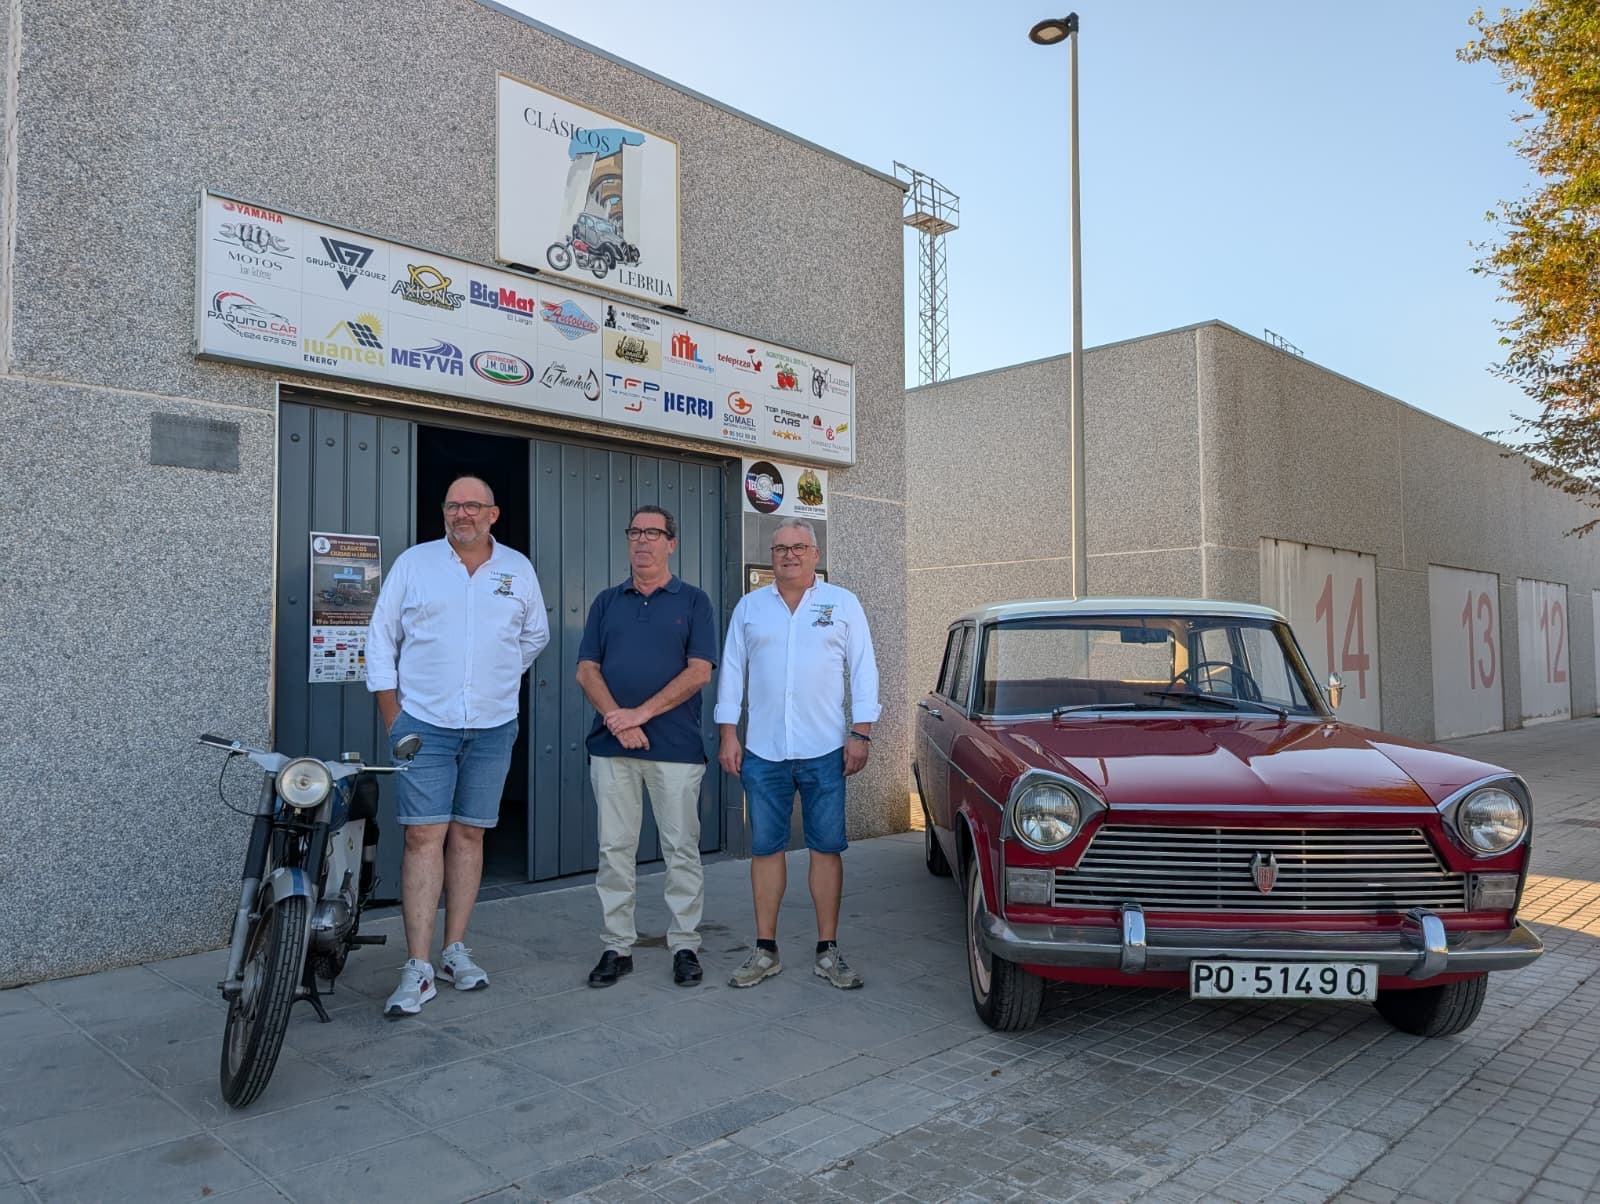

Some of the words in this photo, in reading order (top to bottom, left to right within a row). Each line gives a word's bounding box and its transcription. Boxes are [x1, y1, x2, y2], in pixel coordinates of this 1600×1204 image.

[523, 107, 610, 152] CLÁSICOS
[236, 203, 283, 224] YAMAHA
[228, 251, 283, 271] MOTOS
[306, 256, 336, 269] GRUPO
[619, 268, 674, 297] LEBRIJA
[470, 279, 535, 312] BigMat
[207, 310, 267, 328] PAQUITO
[270, 322, 297, 334] CAR
[303, 354, 338, 366] ENERGY
[391, 347, 464, 376] MEYVA
[717, 353, 751, 369] telepizza
[664, 391, 713, 420] HERBI
[764, 405, 779, 413] TOP
[780, 409, 810, 420] PREMIUM
[723, 413, 756, 427] SOMAEL
[773, 415, 801, 428] CARS
[1315, 574, 1370, 699] 14
[1462, 590, 1496, 690] 13
[1540, 600, 1566, 683] 12
